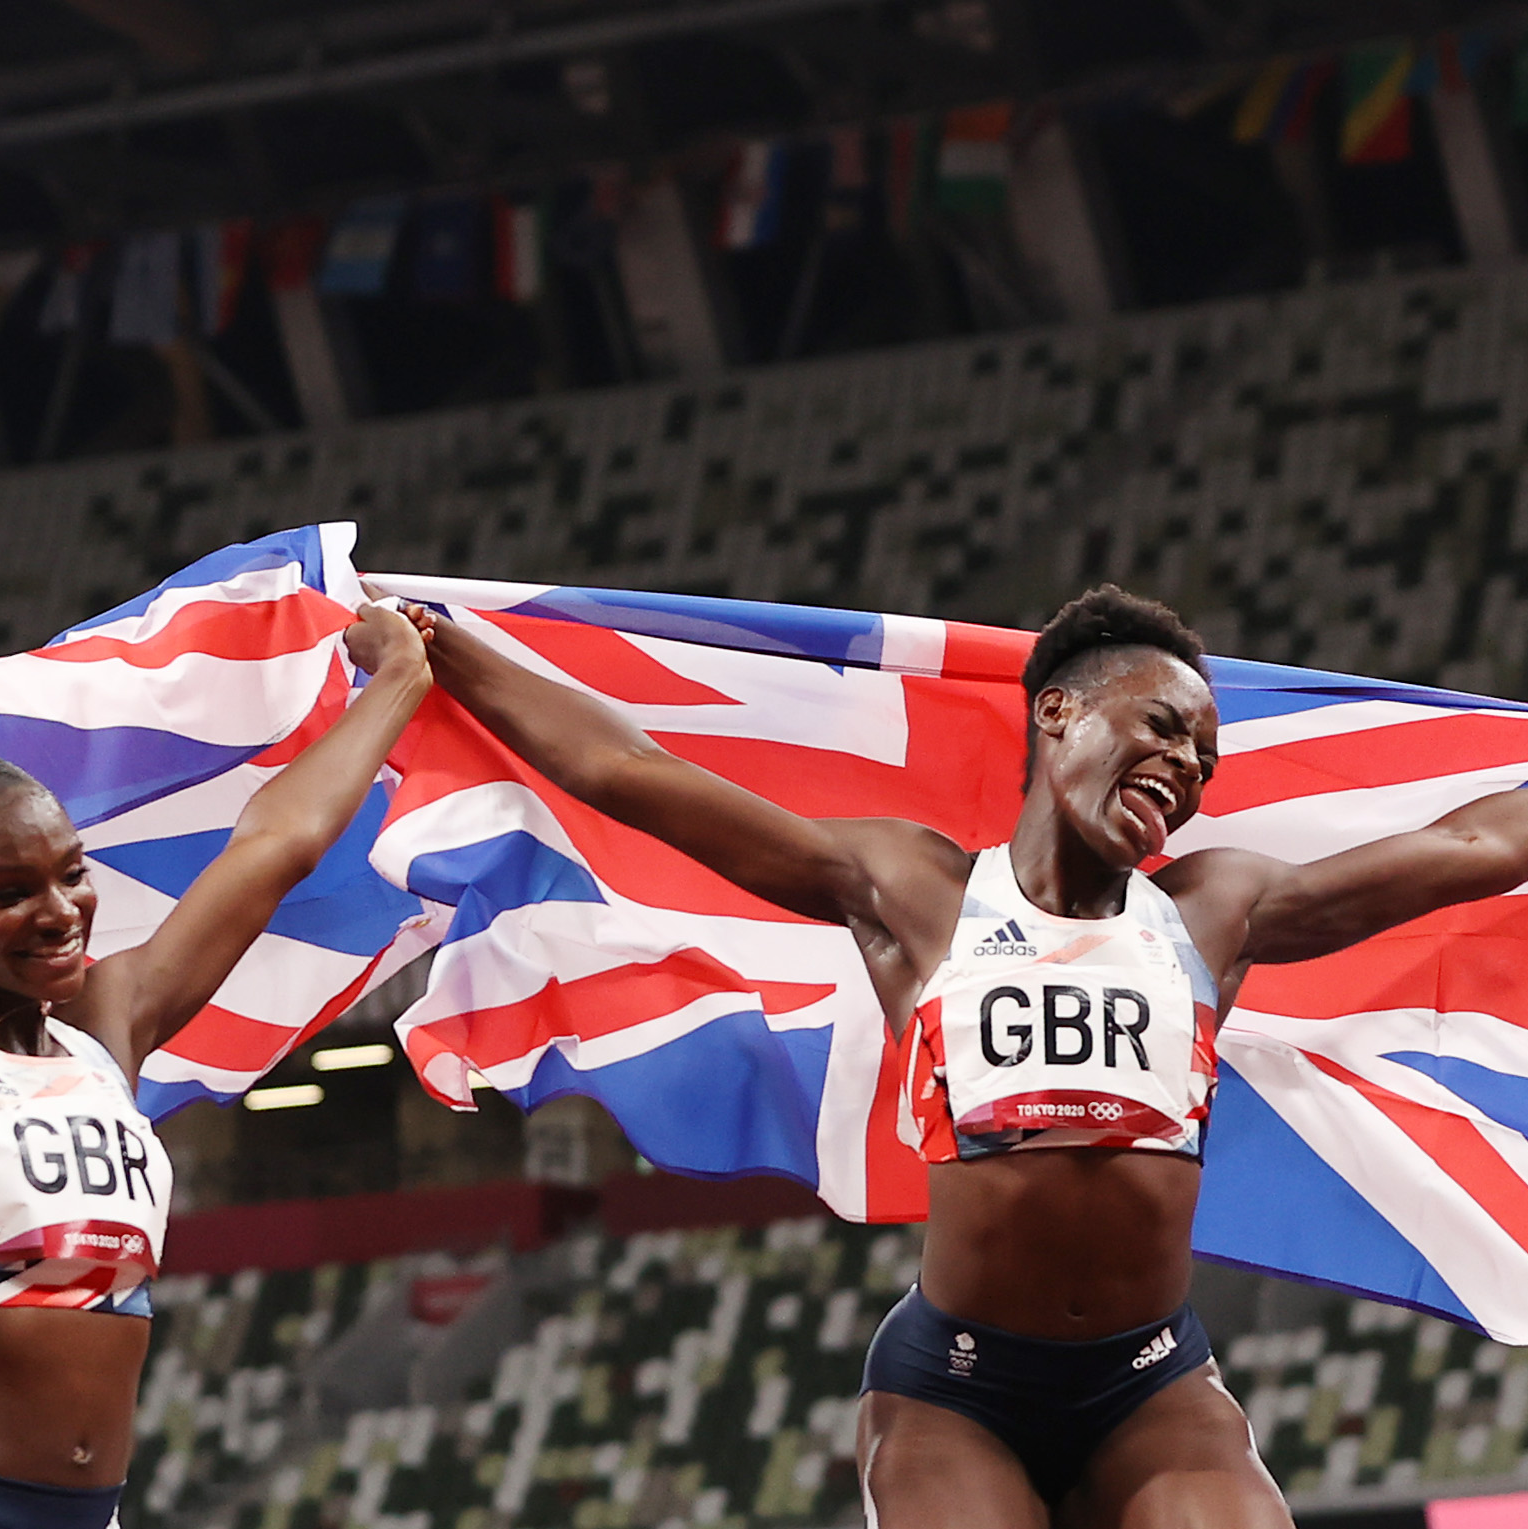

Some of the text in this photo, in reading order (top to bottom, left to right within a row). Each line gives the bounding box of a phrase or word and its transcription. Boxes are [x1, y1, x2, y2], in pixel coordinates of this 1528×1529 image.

[974, 943, 1037, 957] adidas
[980, 985, 1151, 1071] GBR
[1017, 1104, 1086, 1117] TOKYO 2020
[14, 1116, 156, 1207] GBR
